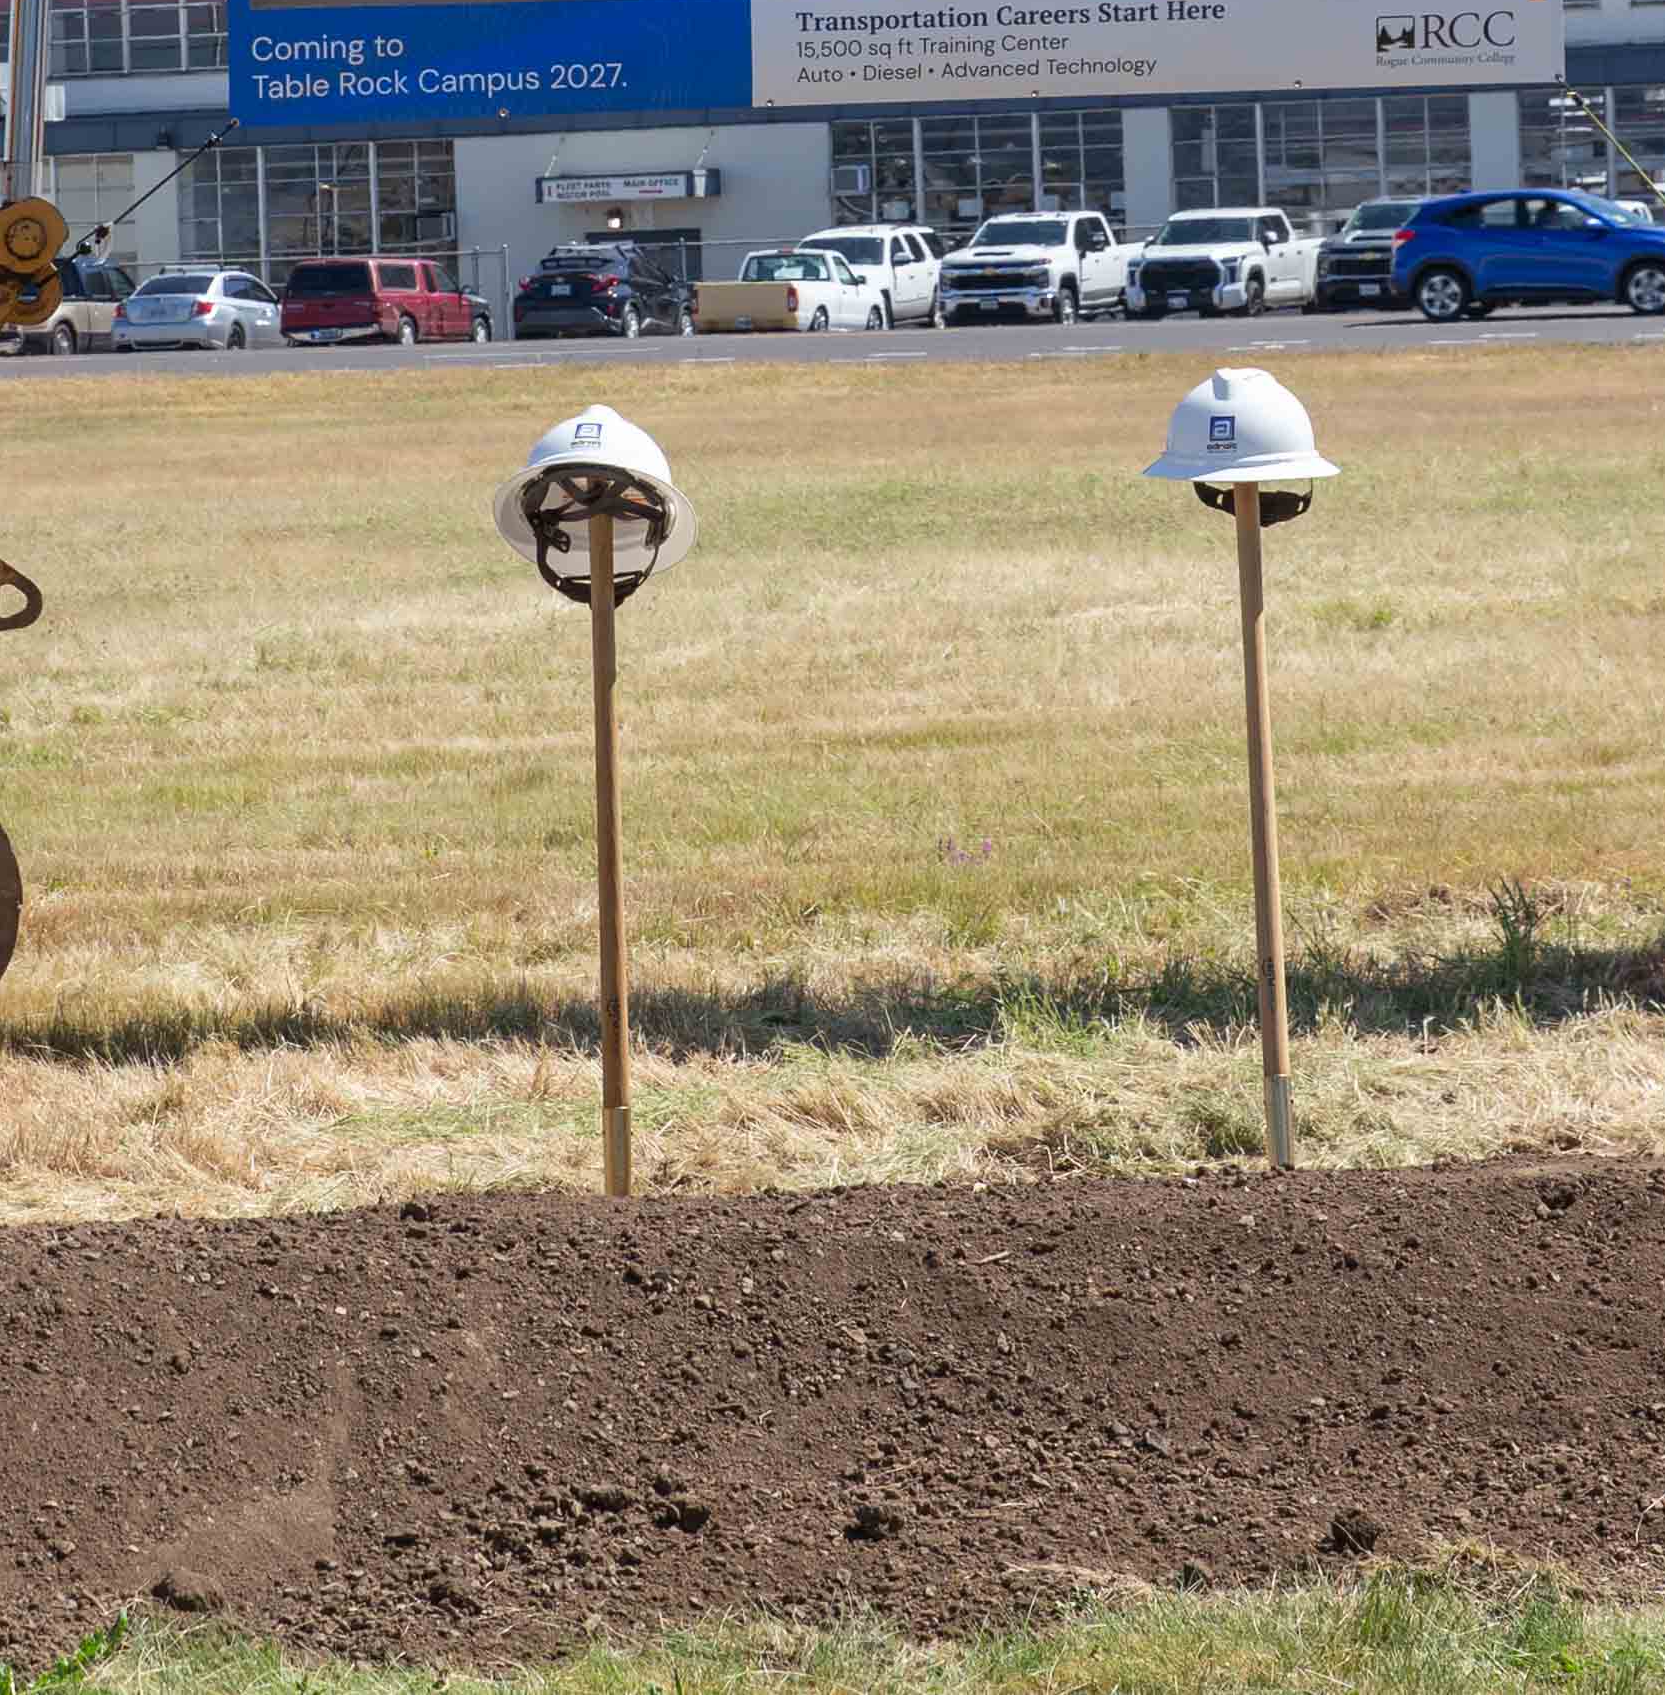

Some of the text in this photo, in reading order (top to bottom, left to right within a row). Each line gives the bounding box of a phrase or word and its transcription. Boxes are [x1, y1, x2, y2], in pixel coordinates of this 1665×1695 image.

[795, 0, 1225, 35] Transportation Careers Start Here
[1420, 10, 1516, 49] RCC
[251, 34, 404, 65] Coming to
[796, 34, 1070, 60] 15,500 sq ft Training Center
[252, 62, 628, 99] Table Rock Campus 2027.
[797, 57, 1157, 84] Auto Diesel Advanced Technology
